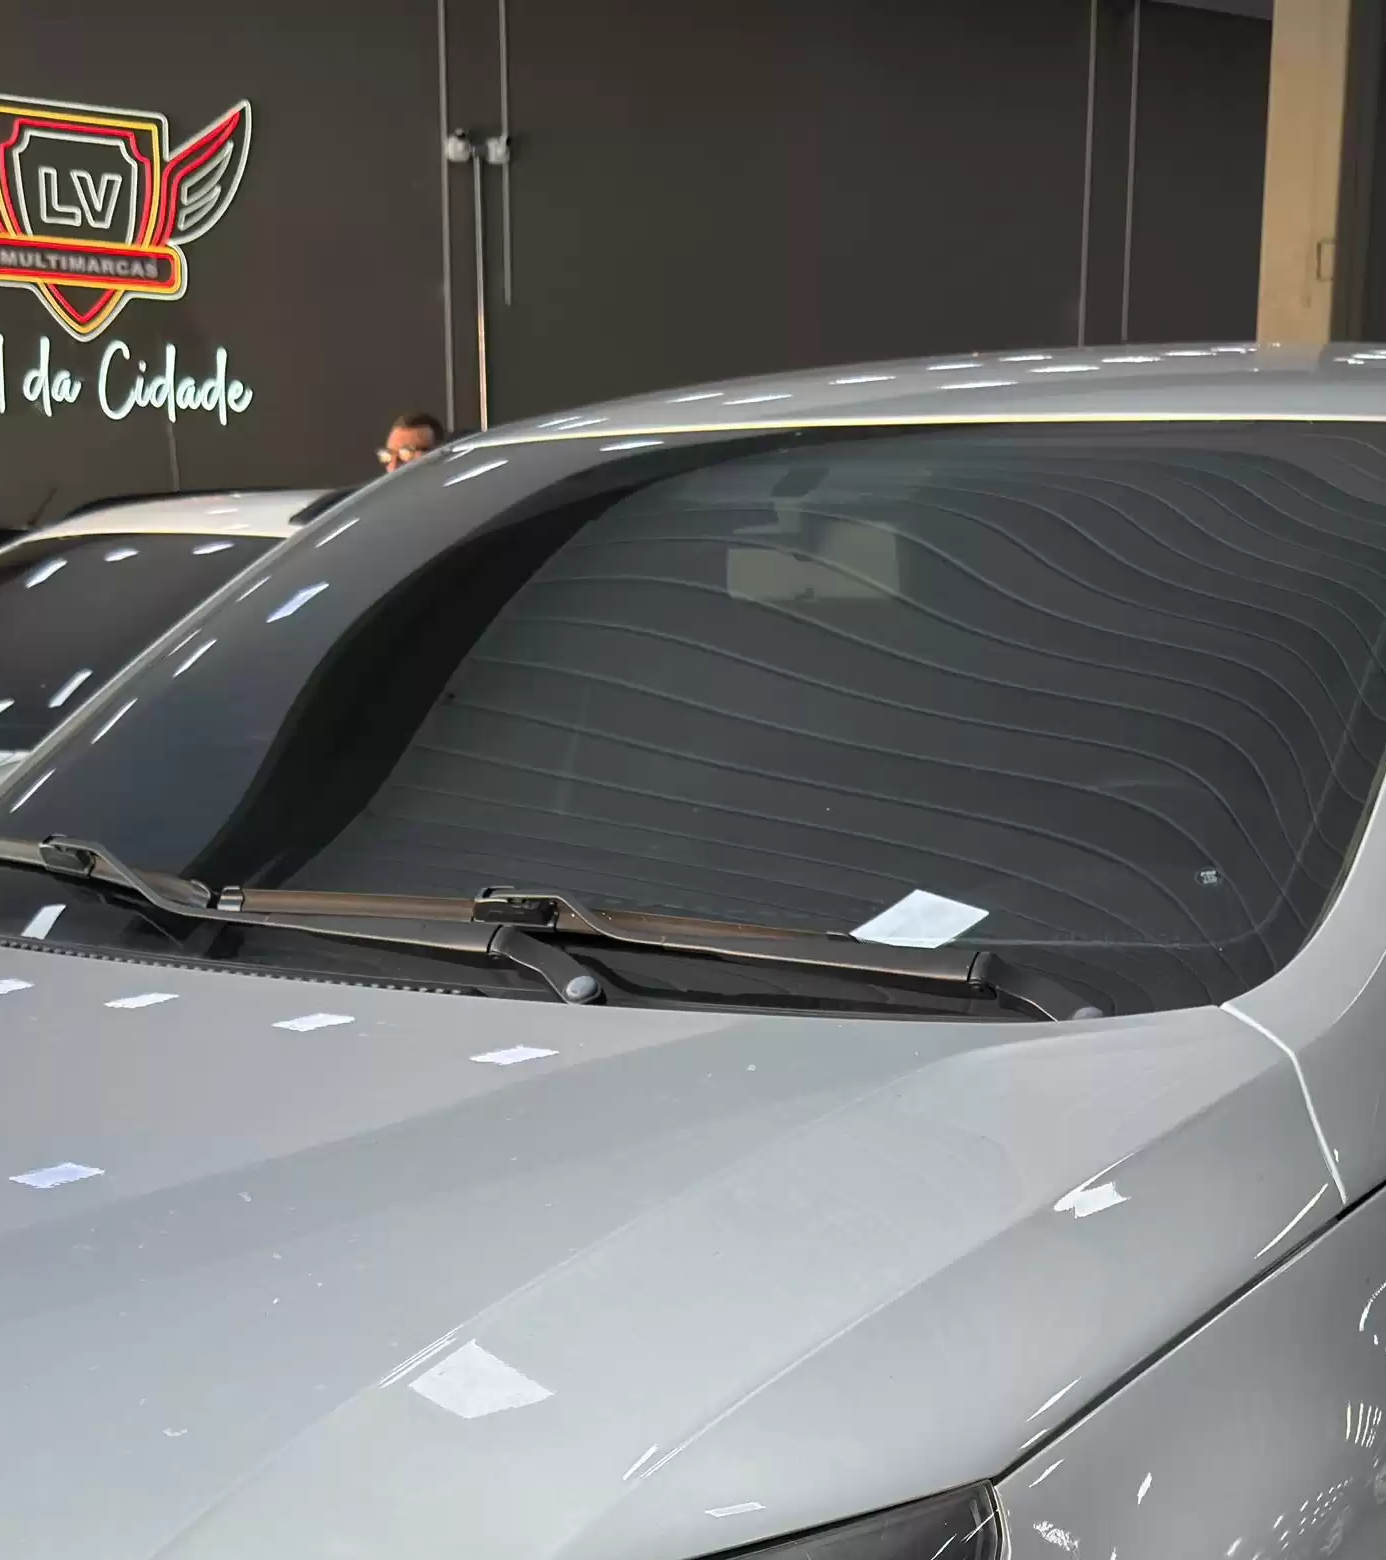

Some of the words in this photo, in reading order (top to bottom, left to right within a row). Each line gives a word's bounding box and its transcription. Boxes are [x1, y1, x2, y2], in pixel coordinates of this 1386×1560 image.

[38, 165, 122, 229] LV
[22, 335, 82, 417] da
[98, 339, 253, 426] Cidade
